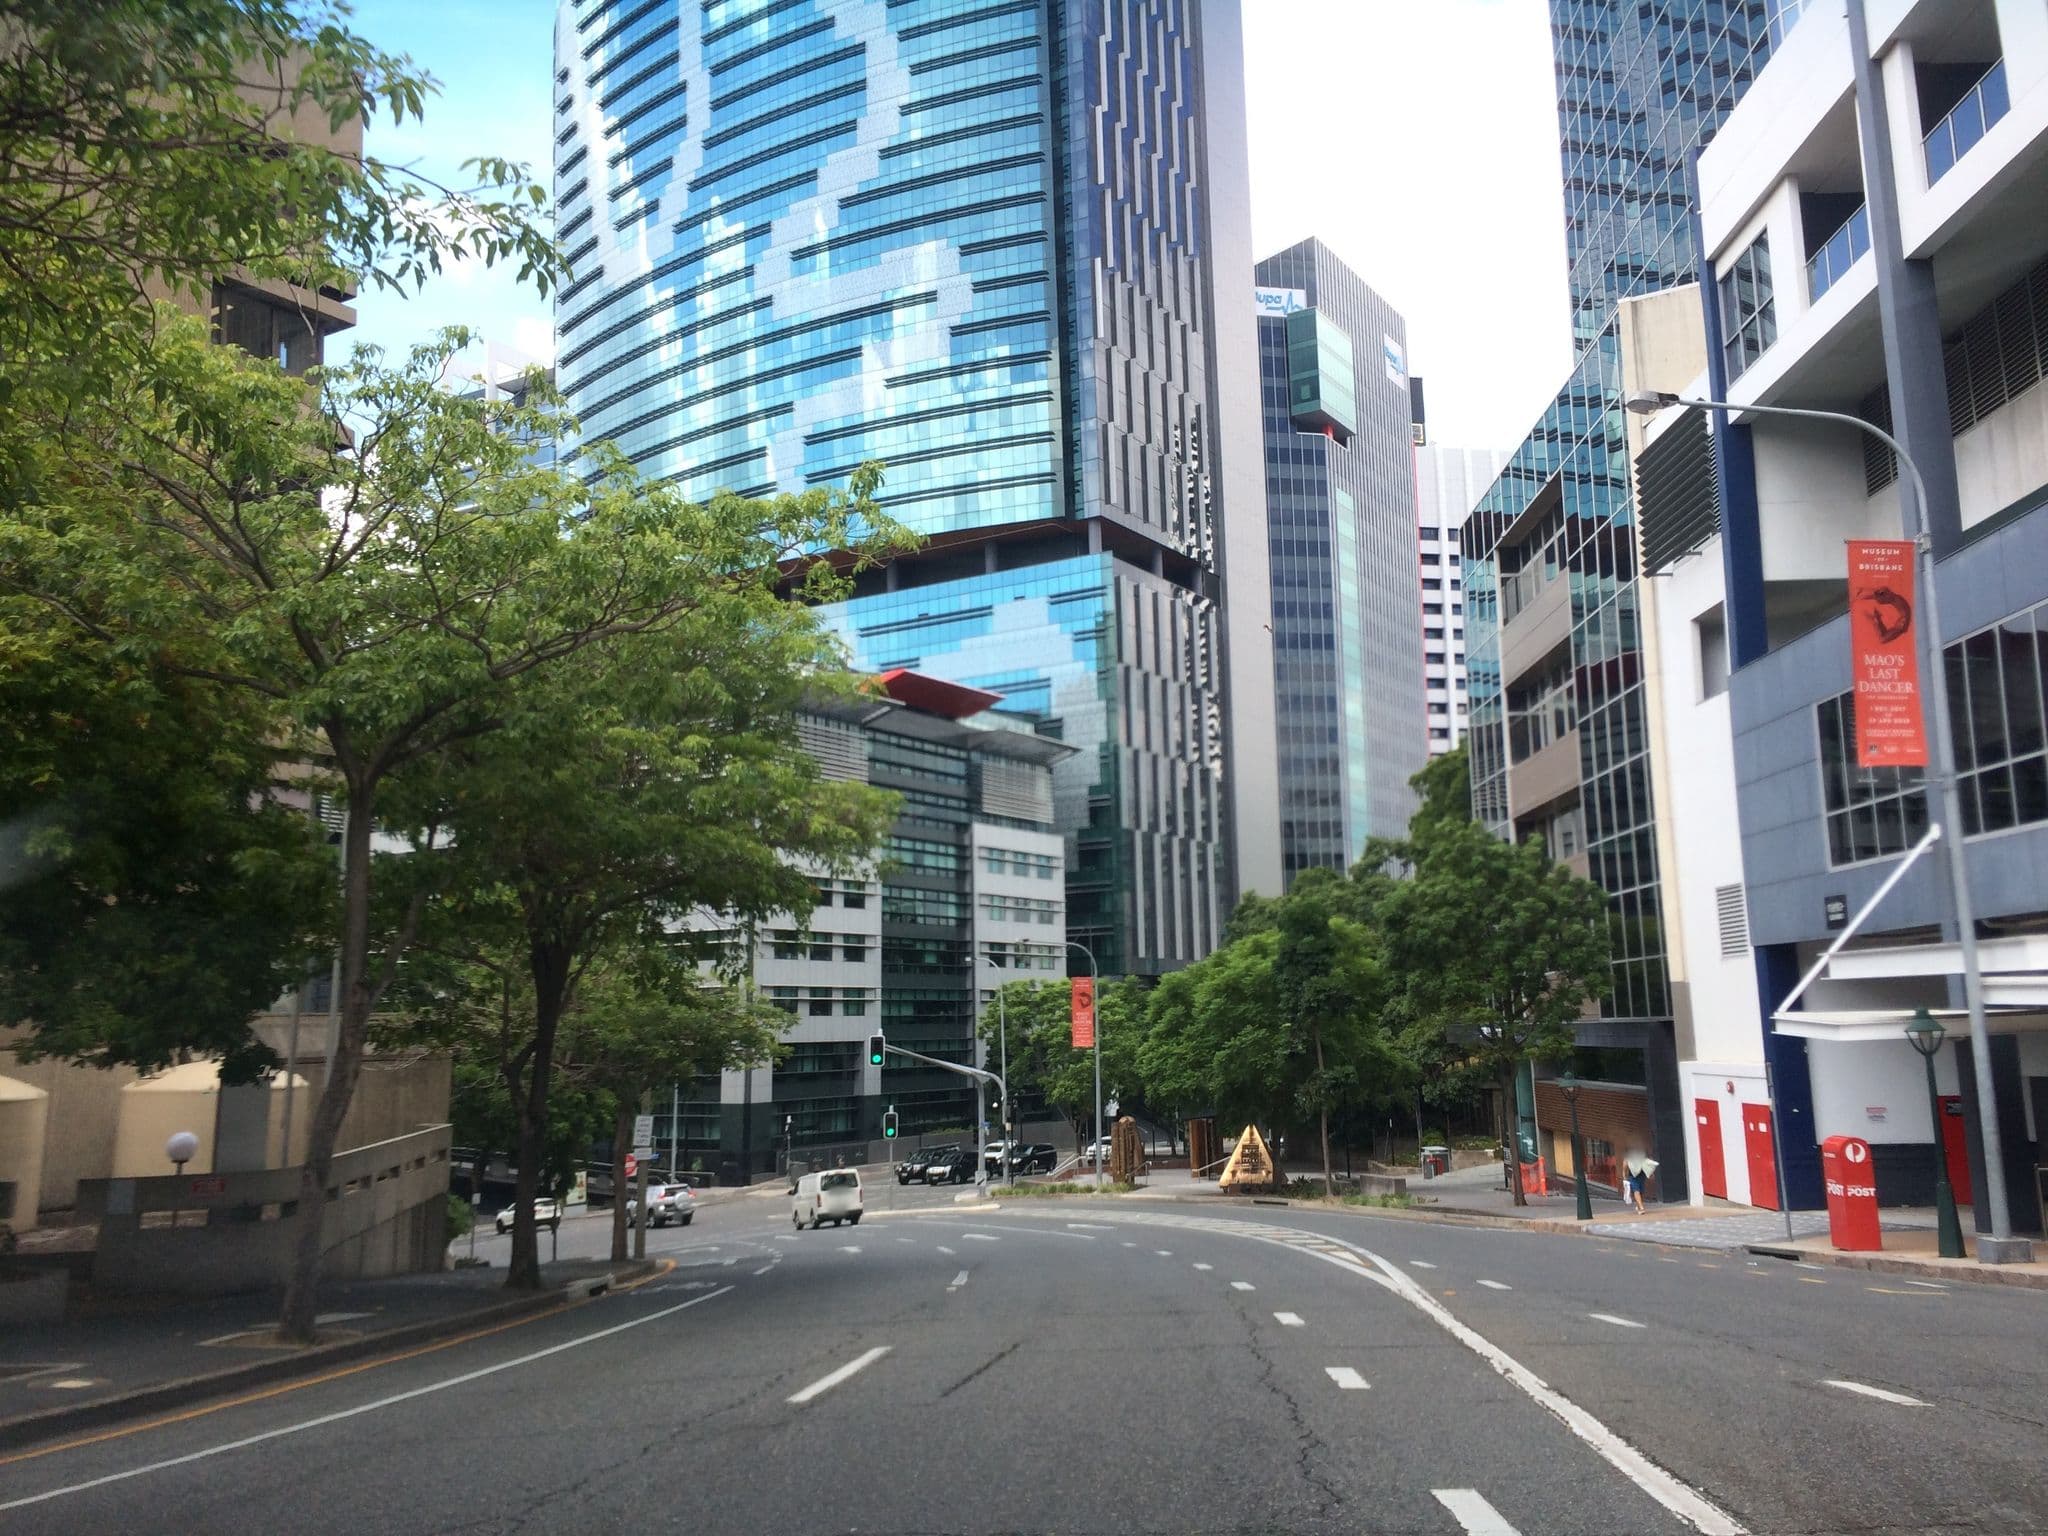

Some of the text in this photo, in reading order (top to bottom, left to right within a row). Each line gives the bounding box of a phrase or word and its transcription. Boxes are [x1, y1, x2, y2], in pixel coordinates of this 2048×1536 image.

[1256, 291, 1282, 305] upa
[1858, 563, 1904, 571] BRISBANE
[1864, 654, 1905, 667] MAO'S
[1868, 667, 1901, 680] LAST
[1859, 680, 1914, 693] DANCER
[1826, 1182, 1844, 1197] POST
[1847, 1187, 1876, 1197] POST
